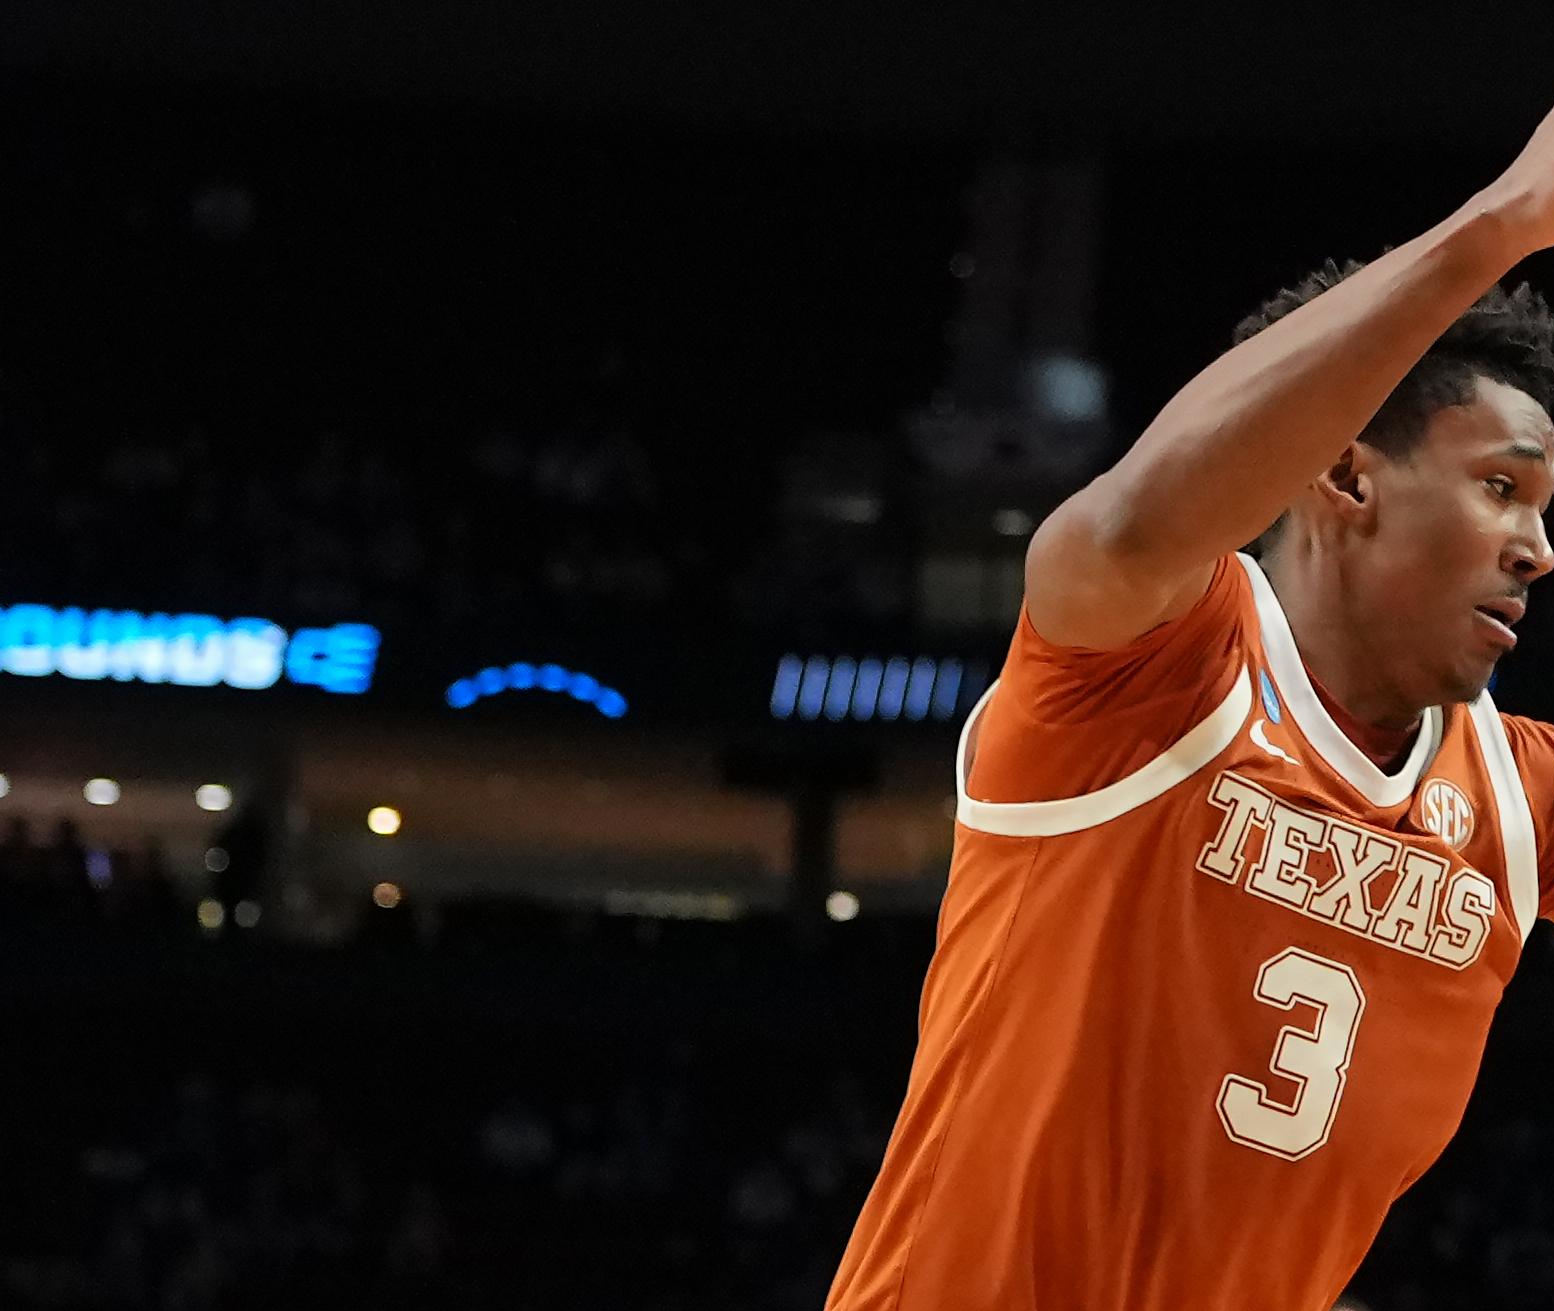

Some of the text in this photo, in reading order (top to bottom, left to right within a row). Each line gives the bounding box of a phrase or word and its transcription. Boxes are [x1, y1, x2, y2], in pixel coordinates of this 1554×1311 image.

[0, 603, 288, 690] OUNDS
[1196, 770, 1496, 971] TEXAS
[1425, 783, 1471, 846] SEC
[1216, 946, 1366, 1161] 3
